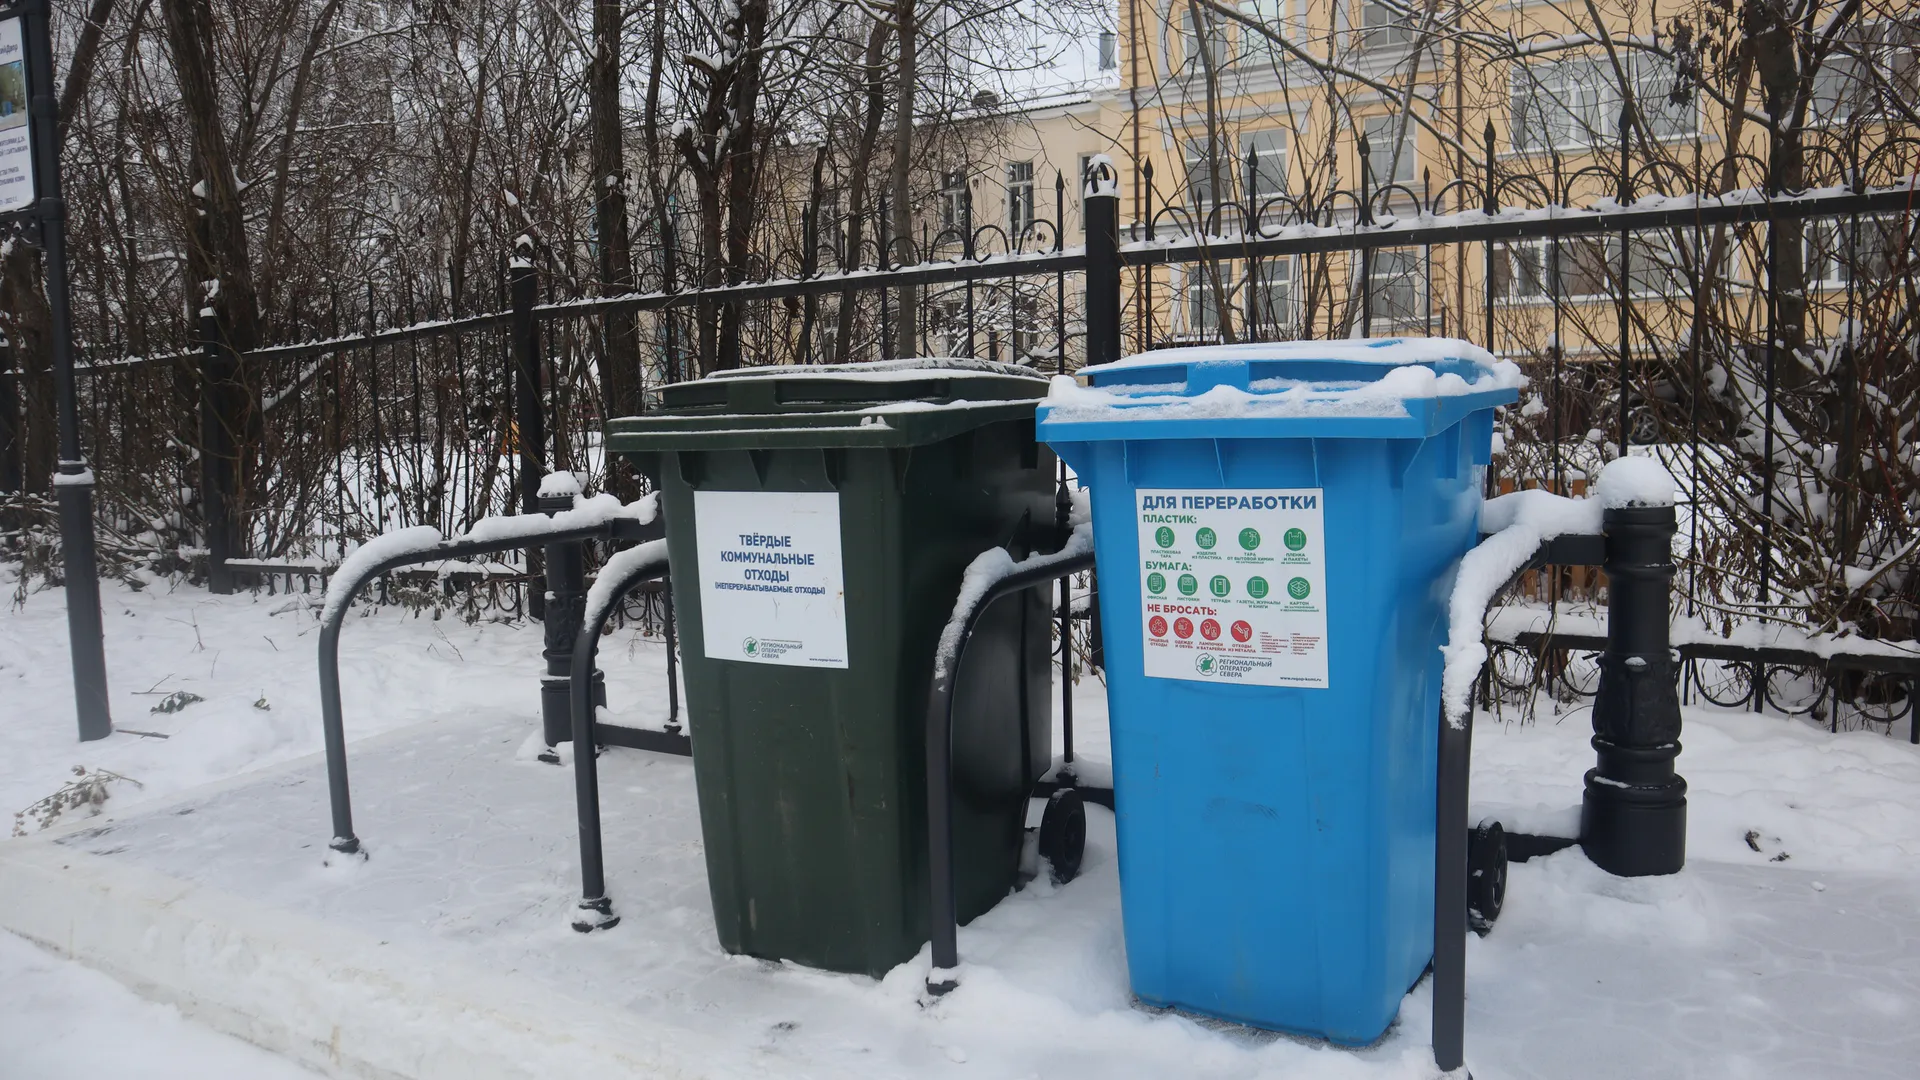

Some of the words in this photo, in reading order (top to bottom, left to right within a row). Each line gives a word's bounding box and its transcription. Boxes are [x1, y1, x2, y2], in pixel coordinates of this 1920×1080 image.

[1142, 496, 1176, 511] ДЛЯ
[1182, 496, 1316, 510] ПЕРЕРАБОТКИ
[1143, 514, 1197, 524] ПЛАСТИК:
[739, 532, 792, 548] ТВЁРДЫЕ
[720, 551, 815, 565] КОММУНАЛЬНЫЕ
[1146, 561, 1192, 571] БУМАГА:
[744, 569, 789, 583] ОТХОДЫ
[715, 582, 793, 594] (НЕПЕРЕРАБАТЫВАЕМЫЕ
[795, 586, 826, 595] ОТХОДЫ)
[1147, 604, 1160, 612] НЕ
[1163, 604, 1217, 616] БРОСАТЬ:
[1219, 658, 1272, 667] РЕГИОНАЛЬНЫЙ
